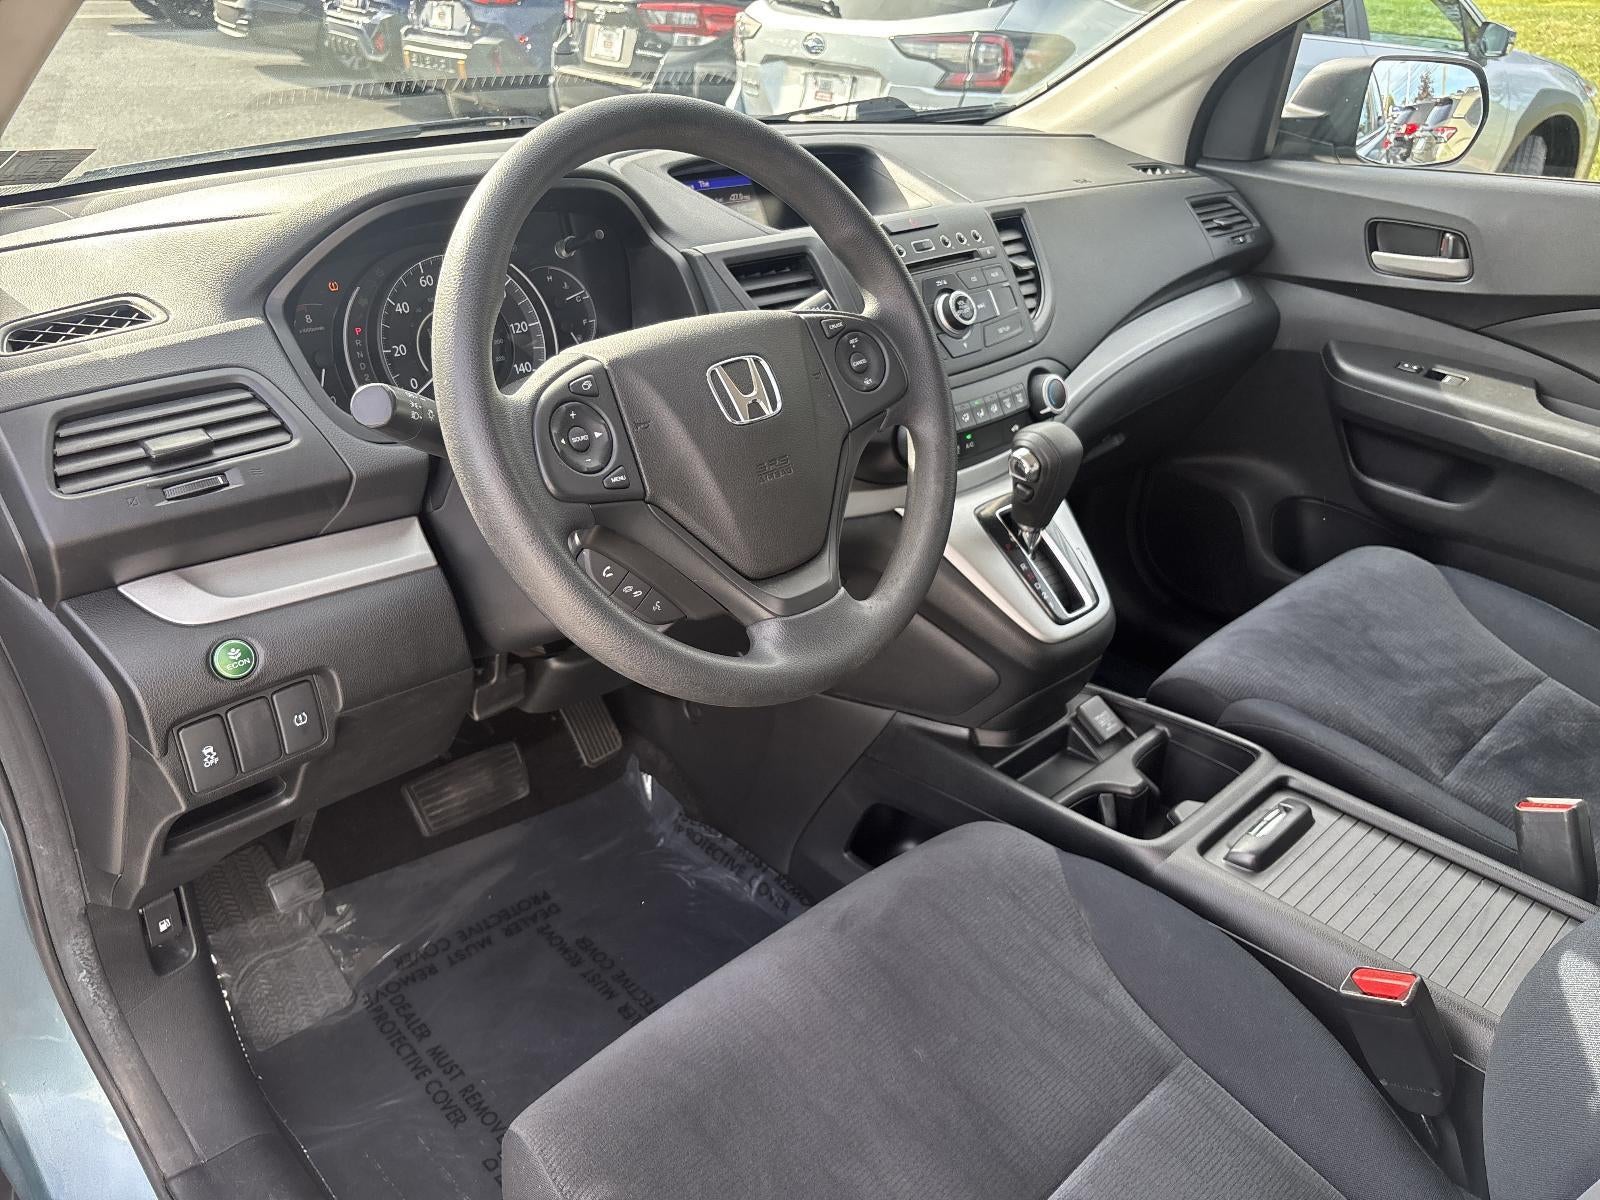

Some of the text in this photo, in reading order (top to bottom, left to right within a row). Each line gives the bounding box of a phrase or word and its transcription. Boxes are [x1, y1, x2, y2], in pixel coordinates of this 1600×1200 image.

[419, 275, 434, 288] 60
[394, 302, 410, 314] 40
[304, 314, 313, 324] 8
[354, 327, 362, 336] P
[510, 321, 528, 334] 120
[355, 339, 362, 347] R
[356, 352, 364, 360] N
[392, 344, 407, 357] 20
[513, 362, 532, 374] 140
[410, 378, 418, 390] 0
[610, 474, 626, 483] MENU
[226, 657, 250, 671] ECON
[204, 756, 219, 768] OFF
[503, 902, 562, 938] DEALER
[393, 889, 551, 970] PROTECTIVE COVER
[448, 935, 493, 967] MUST
[536, 924, 586, 968] REMOVE
[575, 936, 616, 970] COVER
[580, 968, 618, 1001] MUST
[386, 994, 432, 1042] DEALER
[426, 1044, 466, 1082] MUST
[371, 1002, 468, 1129] PROTECTIVE COVER
